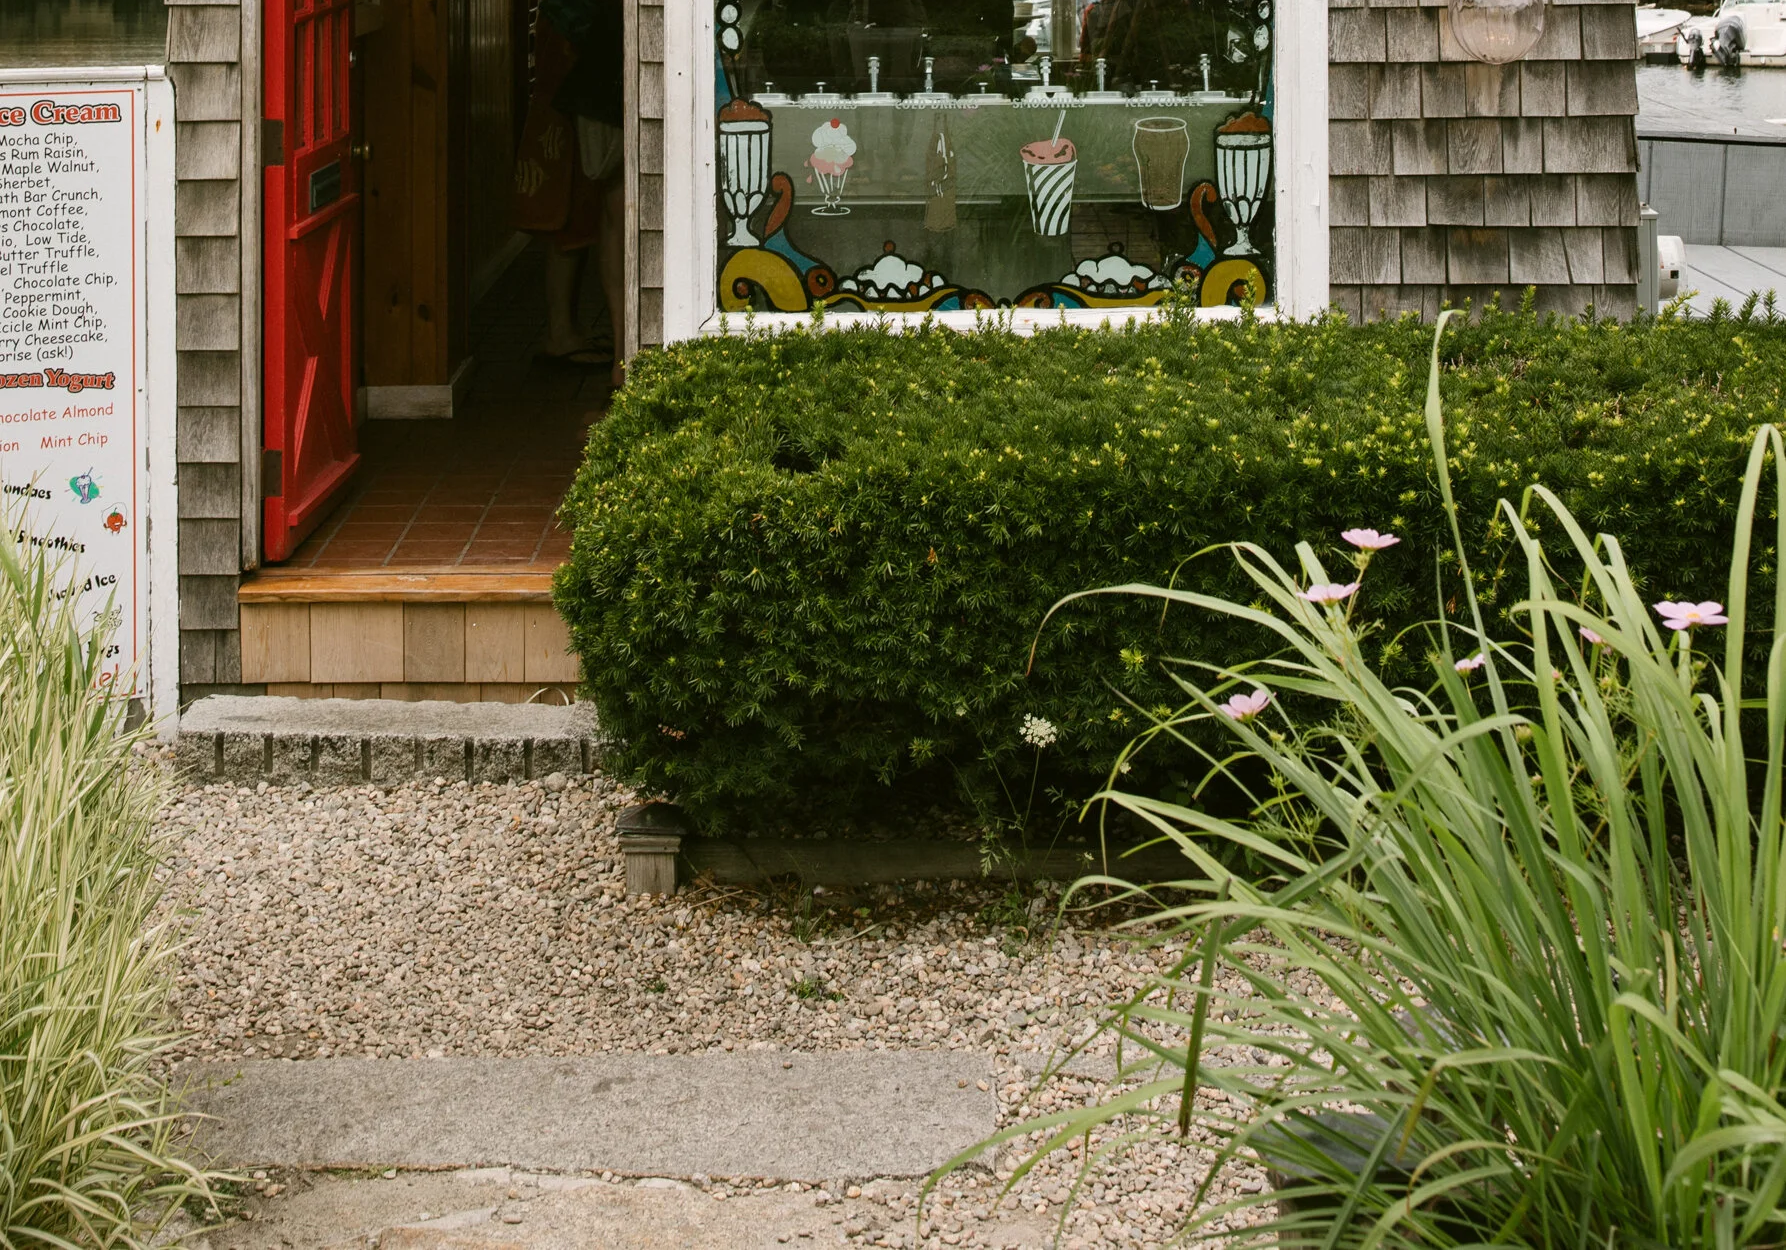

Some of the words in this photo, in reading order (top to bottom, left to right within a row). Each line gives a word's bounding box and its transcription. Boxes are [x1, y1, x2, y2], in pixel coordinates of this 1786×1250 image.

[1012, 97, 1087, 108] SMOOTHIES
[1158, 96, 1204, 107] COFFEE
[30, 100, 122, 125] Cream
[44, 132, 78, 146] Chip,
[11, 149, 39, 160] Rum
[44, 147, 88, 159] Raisin,
[2, 162, 42, 177] Maple
[47, 160, 100, 173] Walnut,
[24, 191, 47, 202] Bar
[52, 188, 103, 201] Crunch,
[37, 203, 88, 216] Coffee,
[13, 218, 84, 232] Chocolate,
[26, 234, 52, 246] Low
[57, 231, 91, 244] Tide,
[0, 250, 39, 261] utter
[45, 245, 100, 258] Truffle,
[18, 261, 69, 274] Truffle
[13, 275, 80, 289] Chocolate
[85, 272, 118, 287] Chip,
[5, 289, 86, 306] Peppermint,
[2, 305, 48, 319] Cookie
[52, 302, 98, 317] Dough,
[38, 318, 69, 330] Mint
[74, 316, 107, 330] Chip,
[25, 330, 108, 345] Cheesecake,
[37, 346, 74, 362] (ask!)
[44, 368, 115, 393] Yogurt
[62, 401, 114, 418] Almond
[40, 435, 73, 449] Mint
[78, 432, 108, 447] Chip
[2, 481, 52, 499] undaes
[95, 574, 118, 588] Ice
